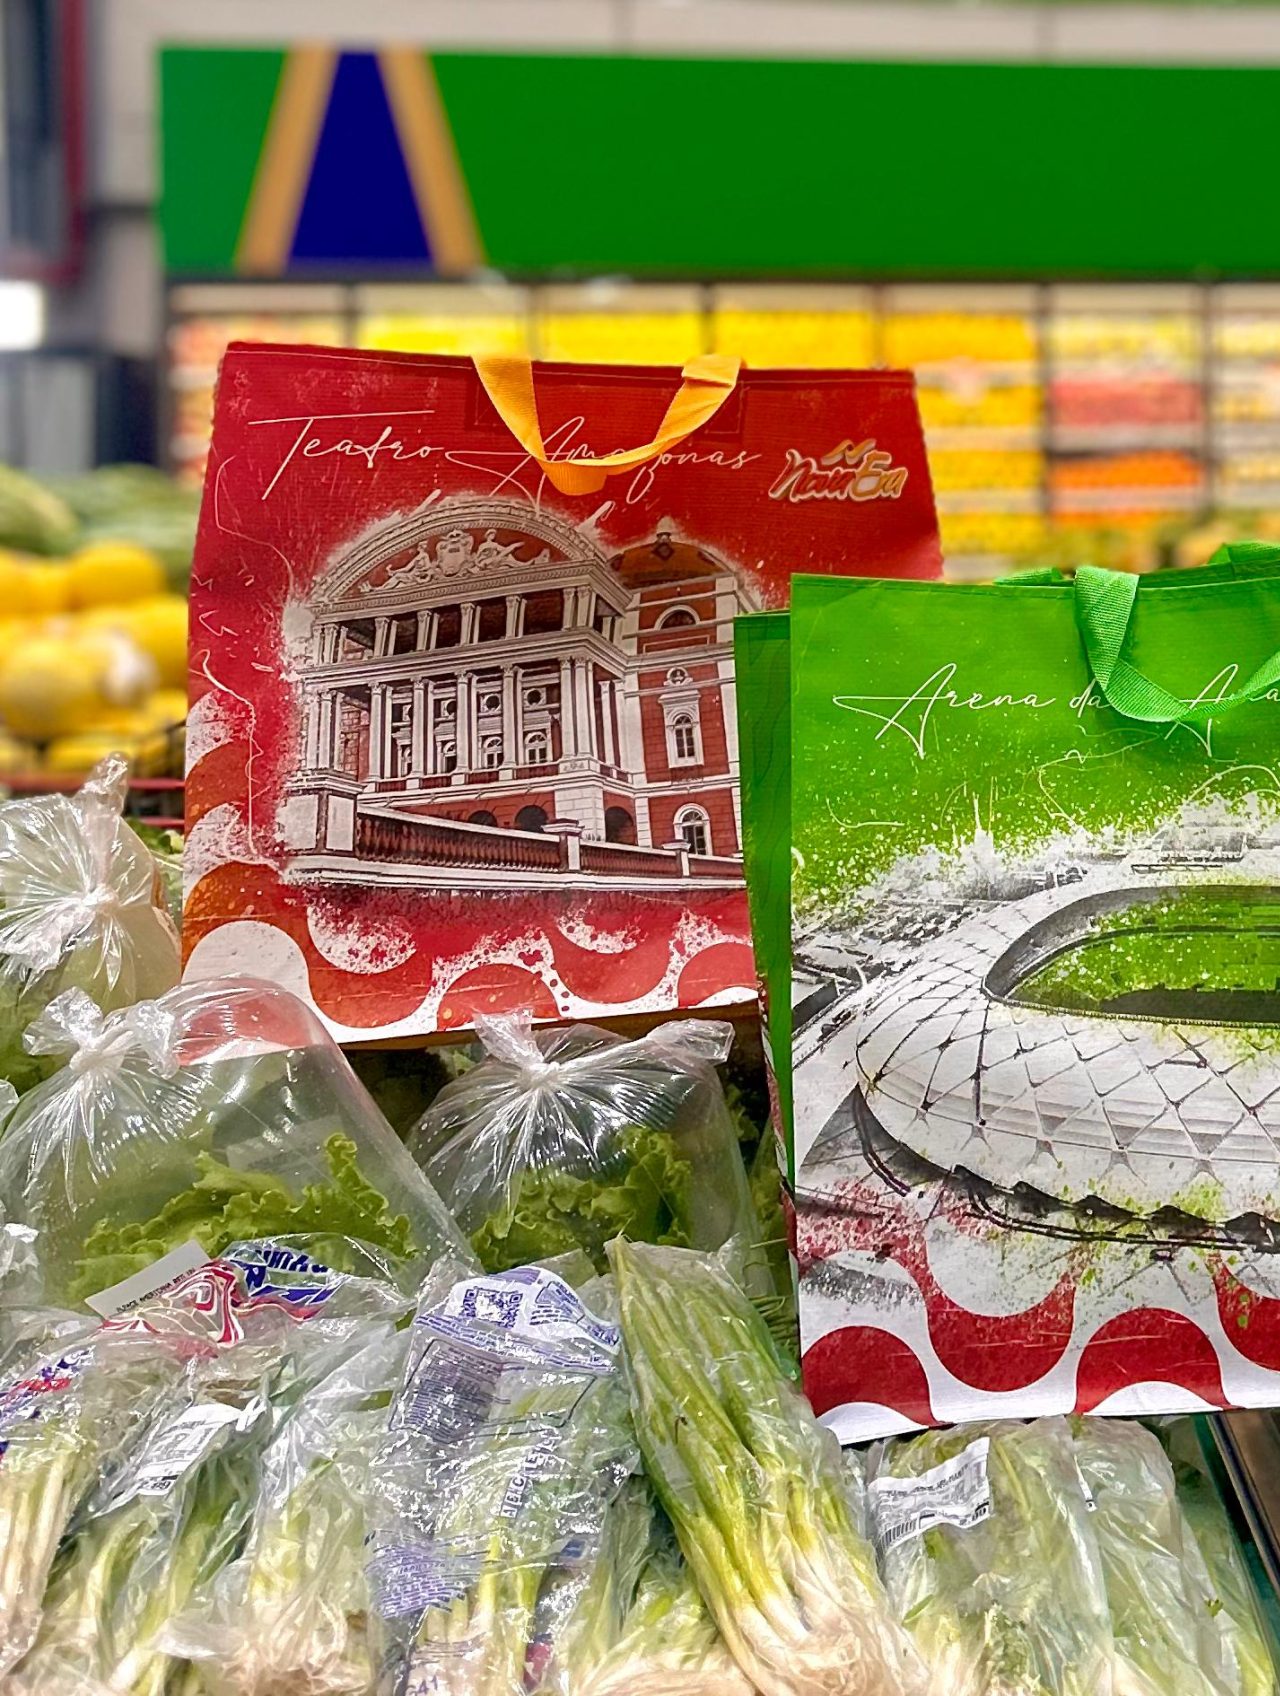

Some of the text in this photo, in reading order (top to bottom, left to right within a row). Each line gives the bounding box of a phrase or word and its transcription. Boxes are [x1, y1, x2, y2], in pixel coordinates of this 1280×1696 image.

[248, 409, 446, 500] Teatro
[833, 662, 1057, 760] Arena
[1068, 677, 1111, 719] da
